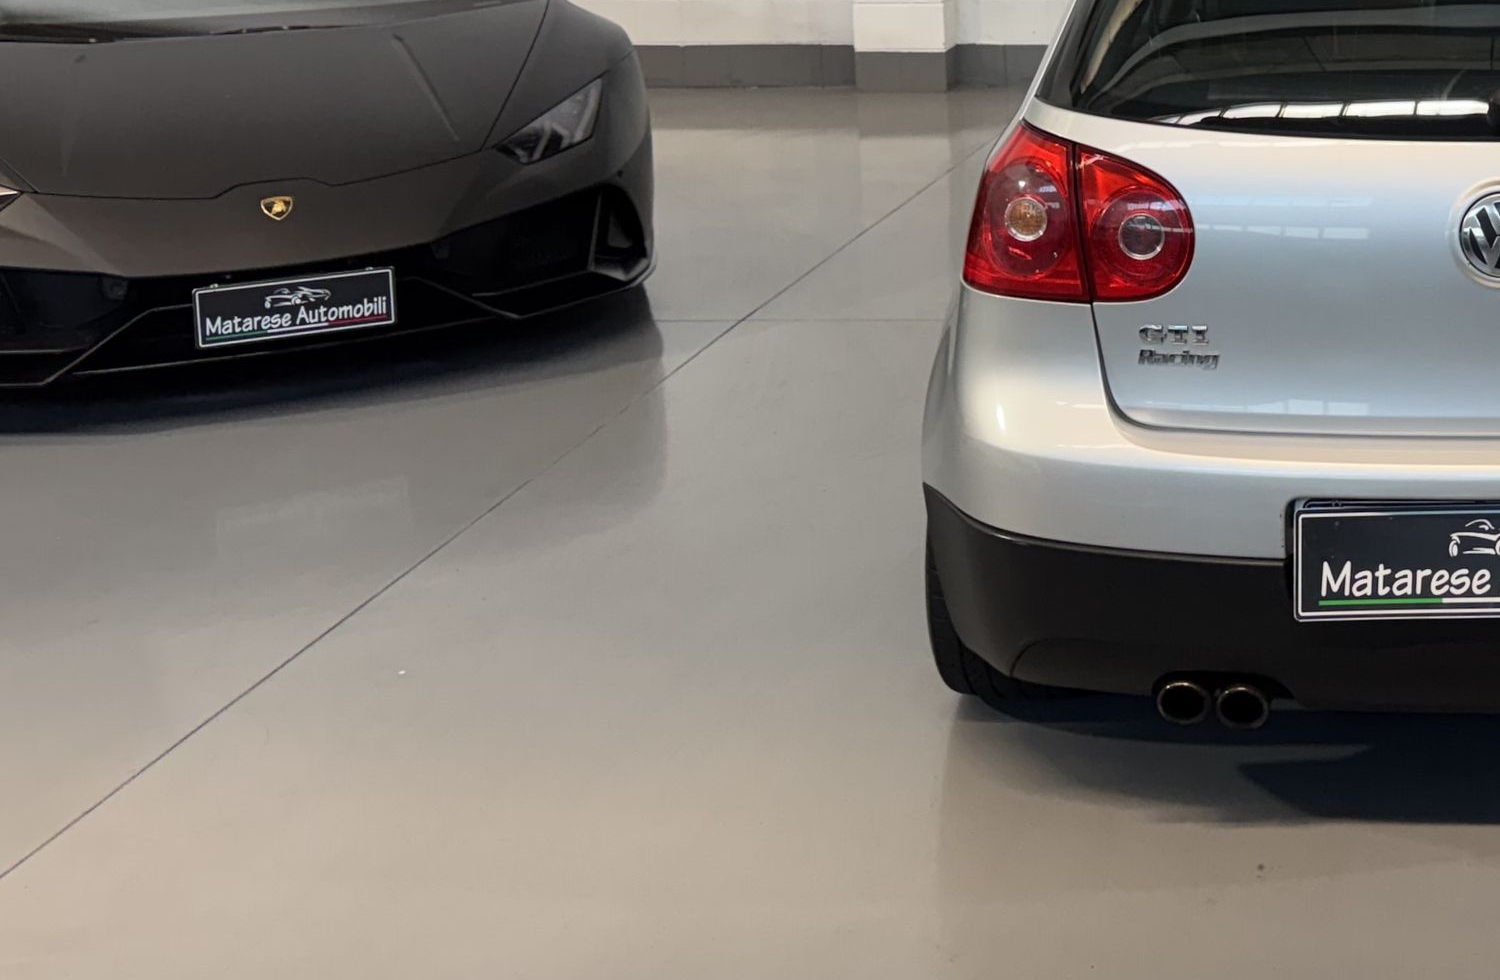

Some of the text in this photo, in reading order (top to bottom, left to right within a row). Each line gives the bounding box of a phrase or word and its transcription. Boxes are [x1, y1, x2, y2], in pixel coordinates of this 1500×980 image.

[205, 295, 388, 337] Matarese Automobili
[1138, 324, 1209, 345] GTI
[1138, 349, 1220, 370] Racing
[1320, 560, 1493, 597] Matarese
